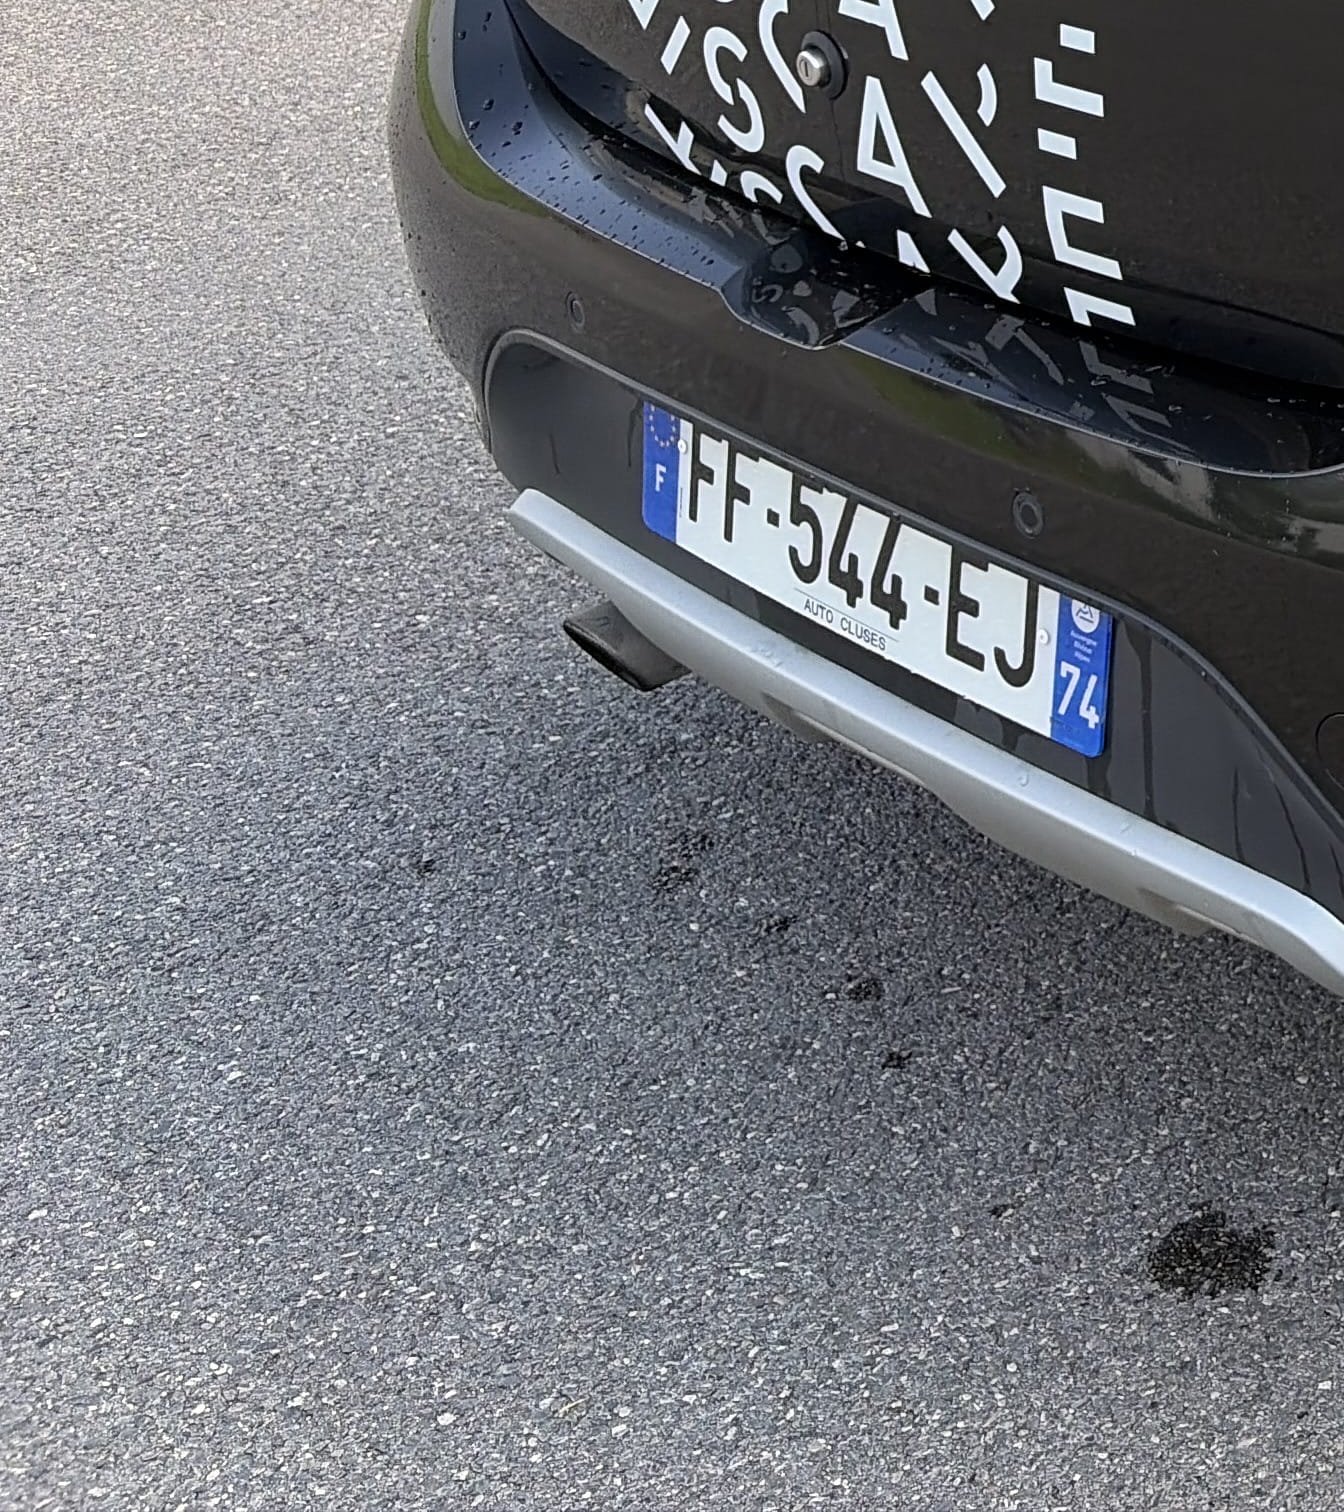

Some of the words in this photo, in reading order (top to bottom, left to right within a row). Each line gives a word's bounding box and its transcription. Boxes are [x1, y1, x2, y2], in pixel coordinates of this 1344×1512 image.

[655, 463, 667, 492] F
[688, 420, 1040, 688] FF-544-EJ
[803, 598, 834, 624] AUTO
[840, 617, 887, 651] CLUSES
[1058, 660, 1100, 729] 74
